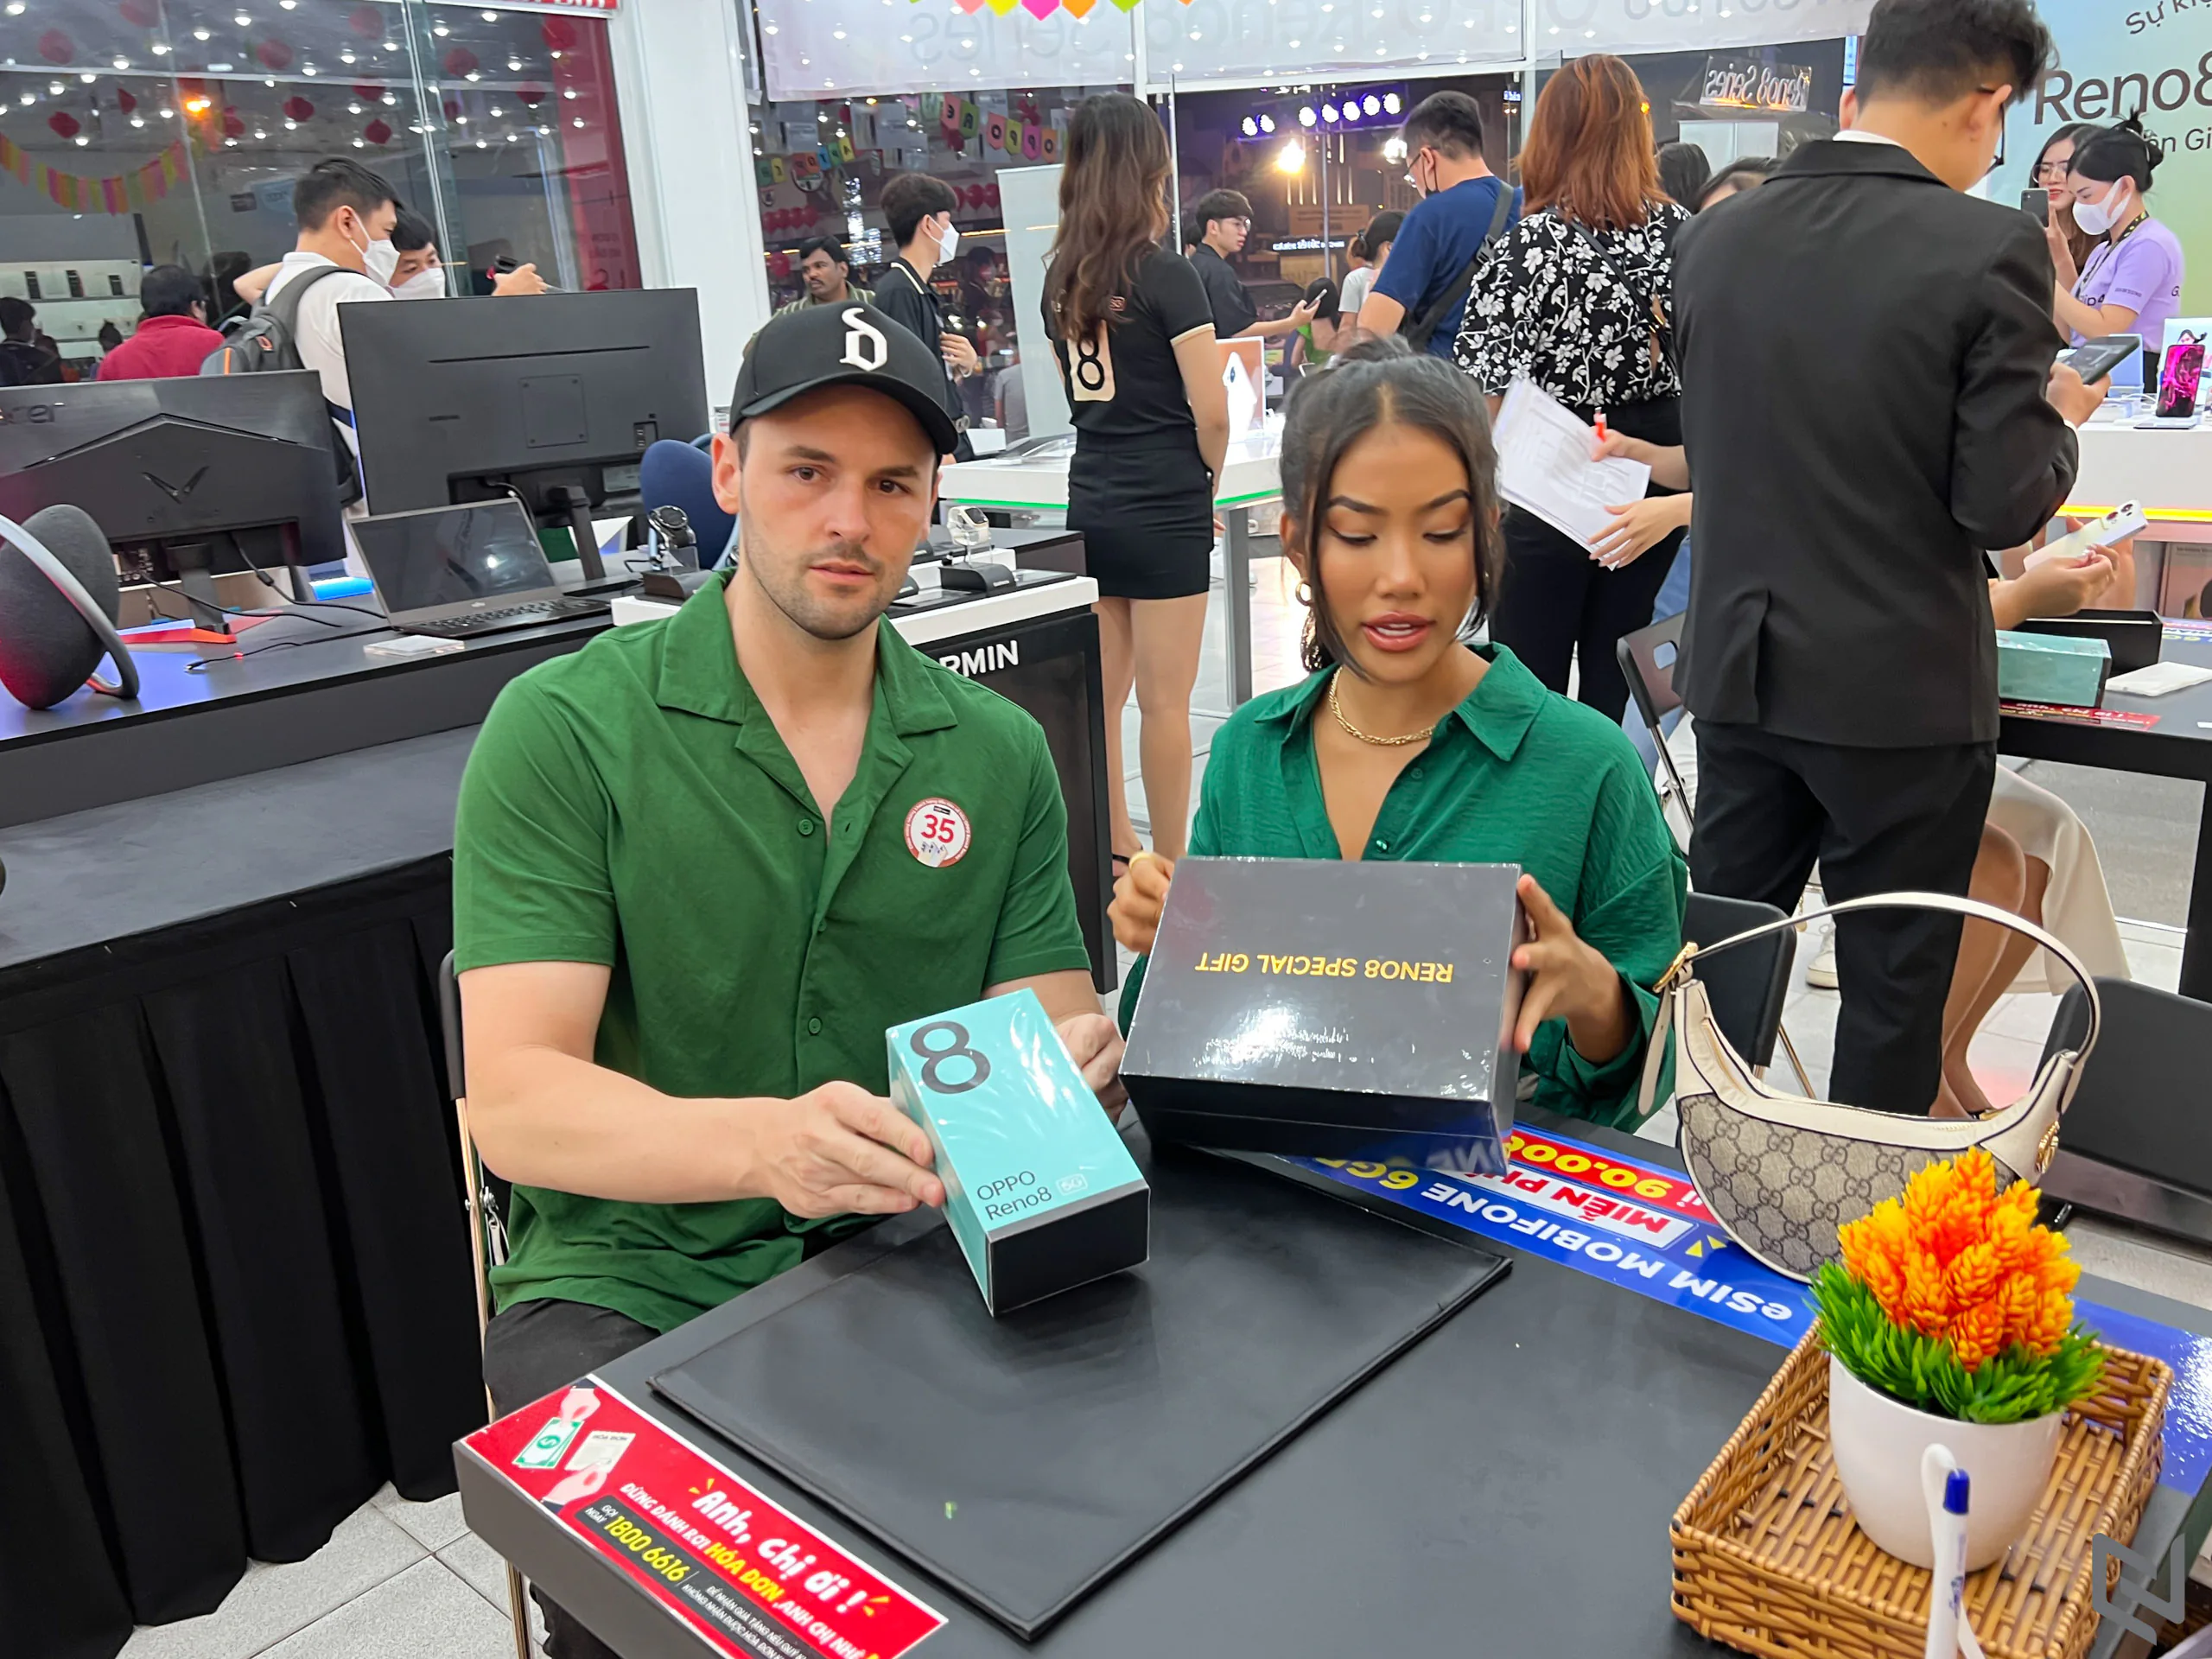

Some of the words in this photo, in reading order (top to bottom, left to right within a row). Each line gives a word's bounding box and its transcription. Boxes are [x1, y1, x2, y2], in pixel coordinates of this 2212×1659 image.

[2126, 1, 2164, 35] Sự
[1077, 339, 1106, 391] 8
[921, 813, 956, 843] 35
[1194, 952, 1249, 973] GIFT
[1256, 953, 1358, 977] SPECIAL
[1363, 959, 1454, 983] RENO8
[909, 1020, 991, 1095] 8
[976, 1170, 1036, 1202] OPPO
[985, 1186, 1052, 1221] Reno8
[1551, 1186, 1671, 1234] MIỄN
[1421, 1182, 1665, 1279] MOBIFONE
[1668, 1270, 1792, 1320] eSIM
[585, 1506, 607, 1524] NGAY
[603, 1515, 652, 1552] 1800
[641, 1547, 690, 1582] 6616
[703, 1541, 746, 1576] HÓA
[808, 1621, 836, 1645] CHỊ
[836, 1590, 868, 1614] !
